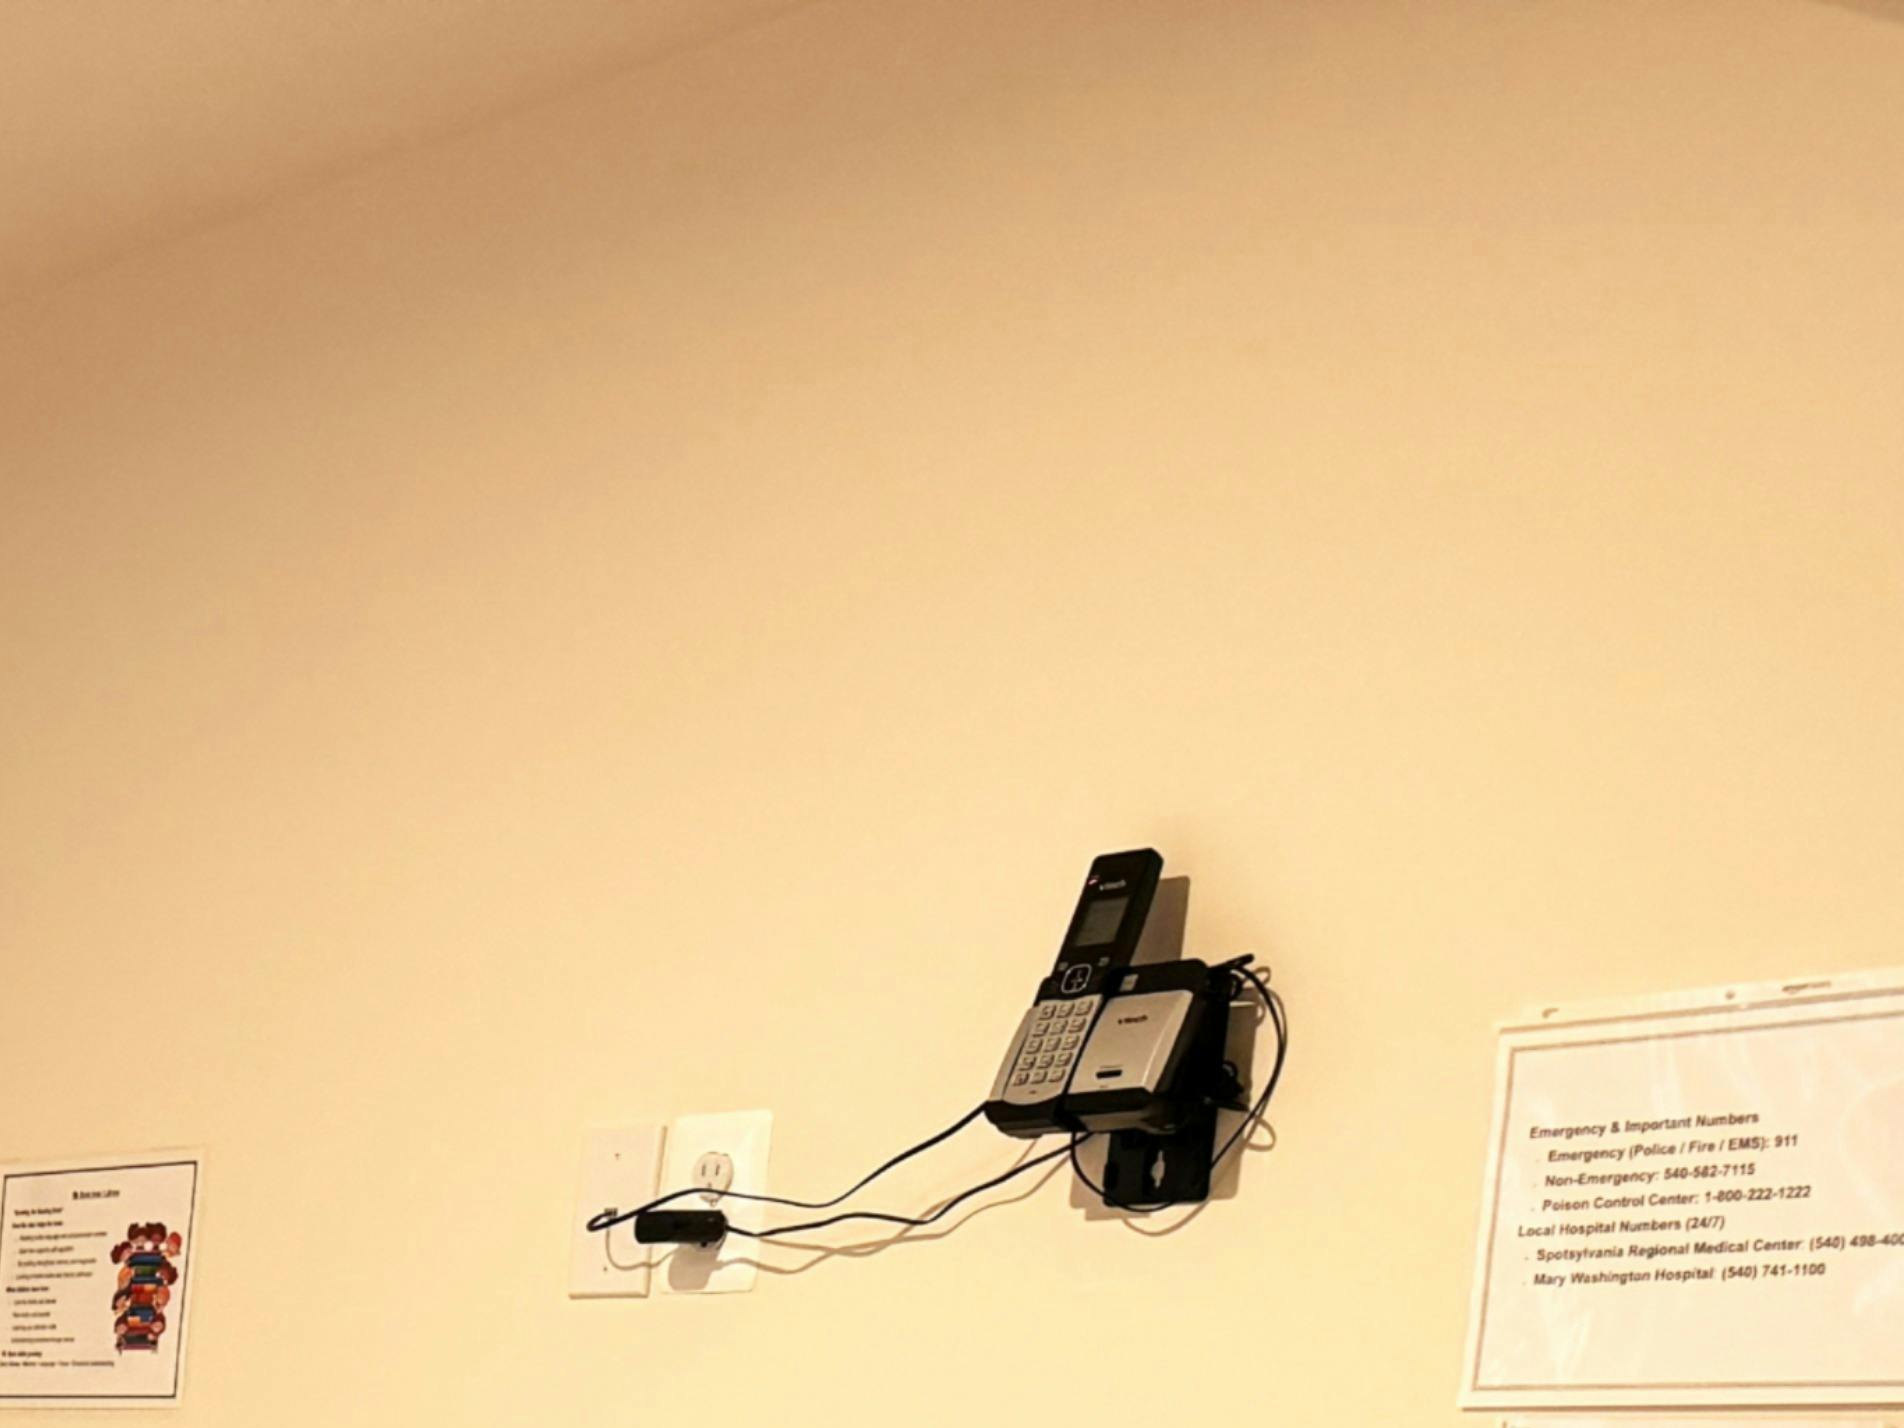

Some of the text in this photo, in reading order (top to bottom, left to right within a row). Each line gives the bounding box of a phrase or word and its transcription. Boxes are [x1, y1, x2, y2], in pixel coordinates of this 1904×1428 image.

[1529, 1112, 1759, 1140] Emergency & Important Numbers
[1548, 1148, 1625, 1163] Emergency
[1629, 1143, 1677, 1161] (Police
[1688, 1140, 1716, 1153] Fire
[1774, 1134, 1799, 1148] 911
[1542, 1199, 1590, 1212] Poison
[1593, 1195, 1645, 1209] Control
[1518, 1215, 1725, 1238] Local Hospital Numbers (24/7)
[1627, 1242, 1690, 1259] Regional
[1693, 1239, 1749, 1255] Medical
[1534, 1272, 1566, 1287] Mary
[1570, 1270, 1651, 1286] Washington
